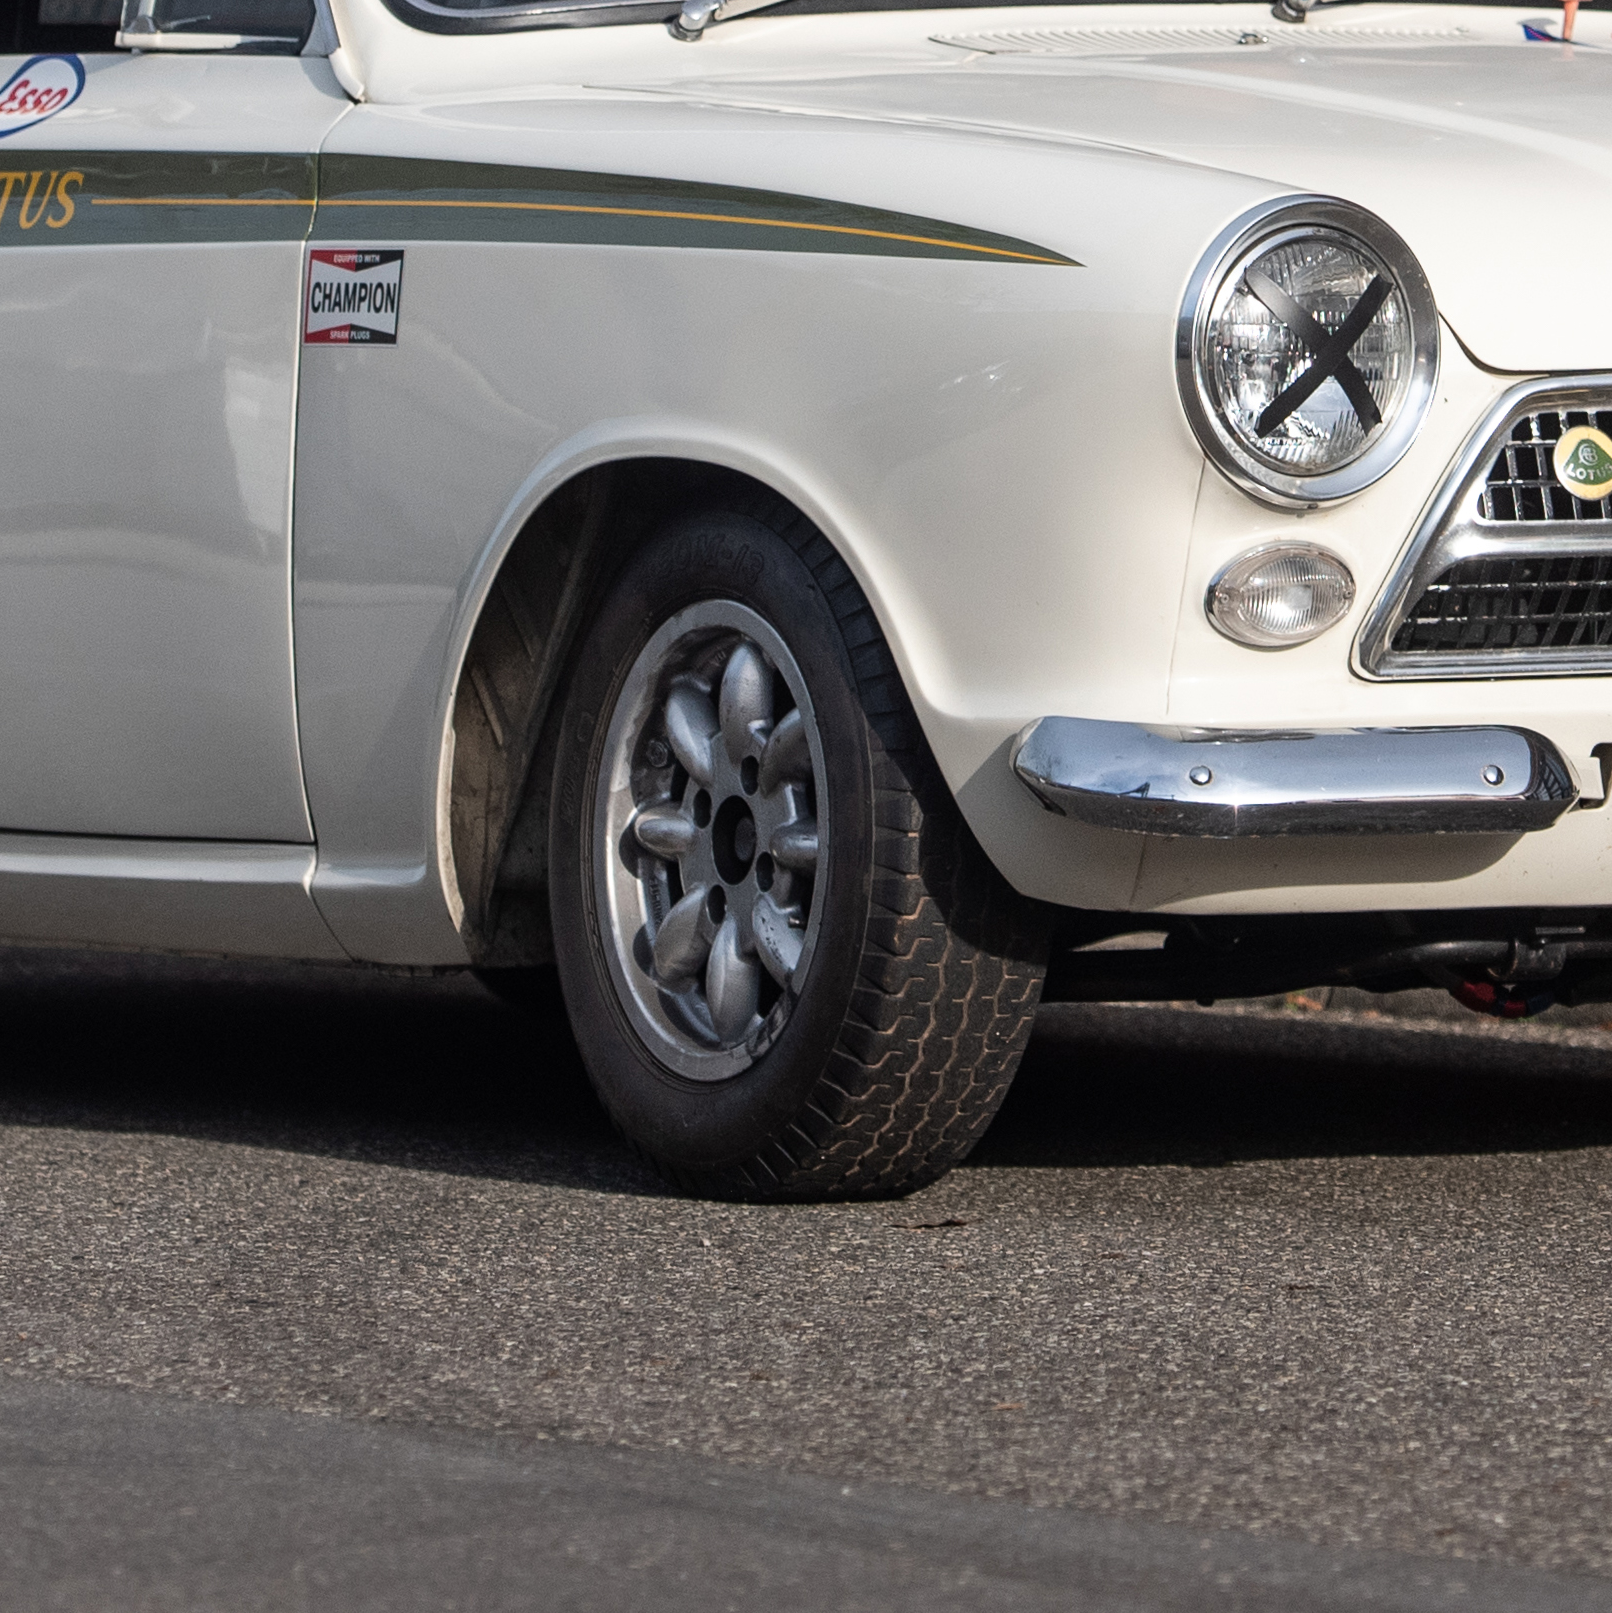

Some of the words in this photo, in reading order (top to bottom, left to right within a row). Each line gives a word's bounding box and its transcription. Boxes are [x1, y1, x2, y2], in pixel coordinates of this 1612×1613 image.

[333, 254, 363, 263] EQUIPPED
[364, 254, 380, 263] WITH
[311, 281, 397, 313] CHAMPION
[329, 330, 349, 339] SPARK
[350, 330, 371, 340] PLUGS
